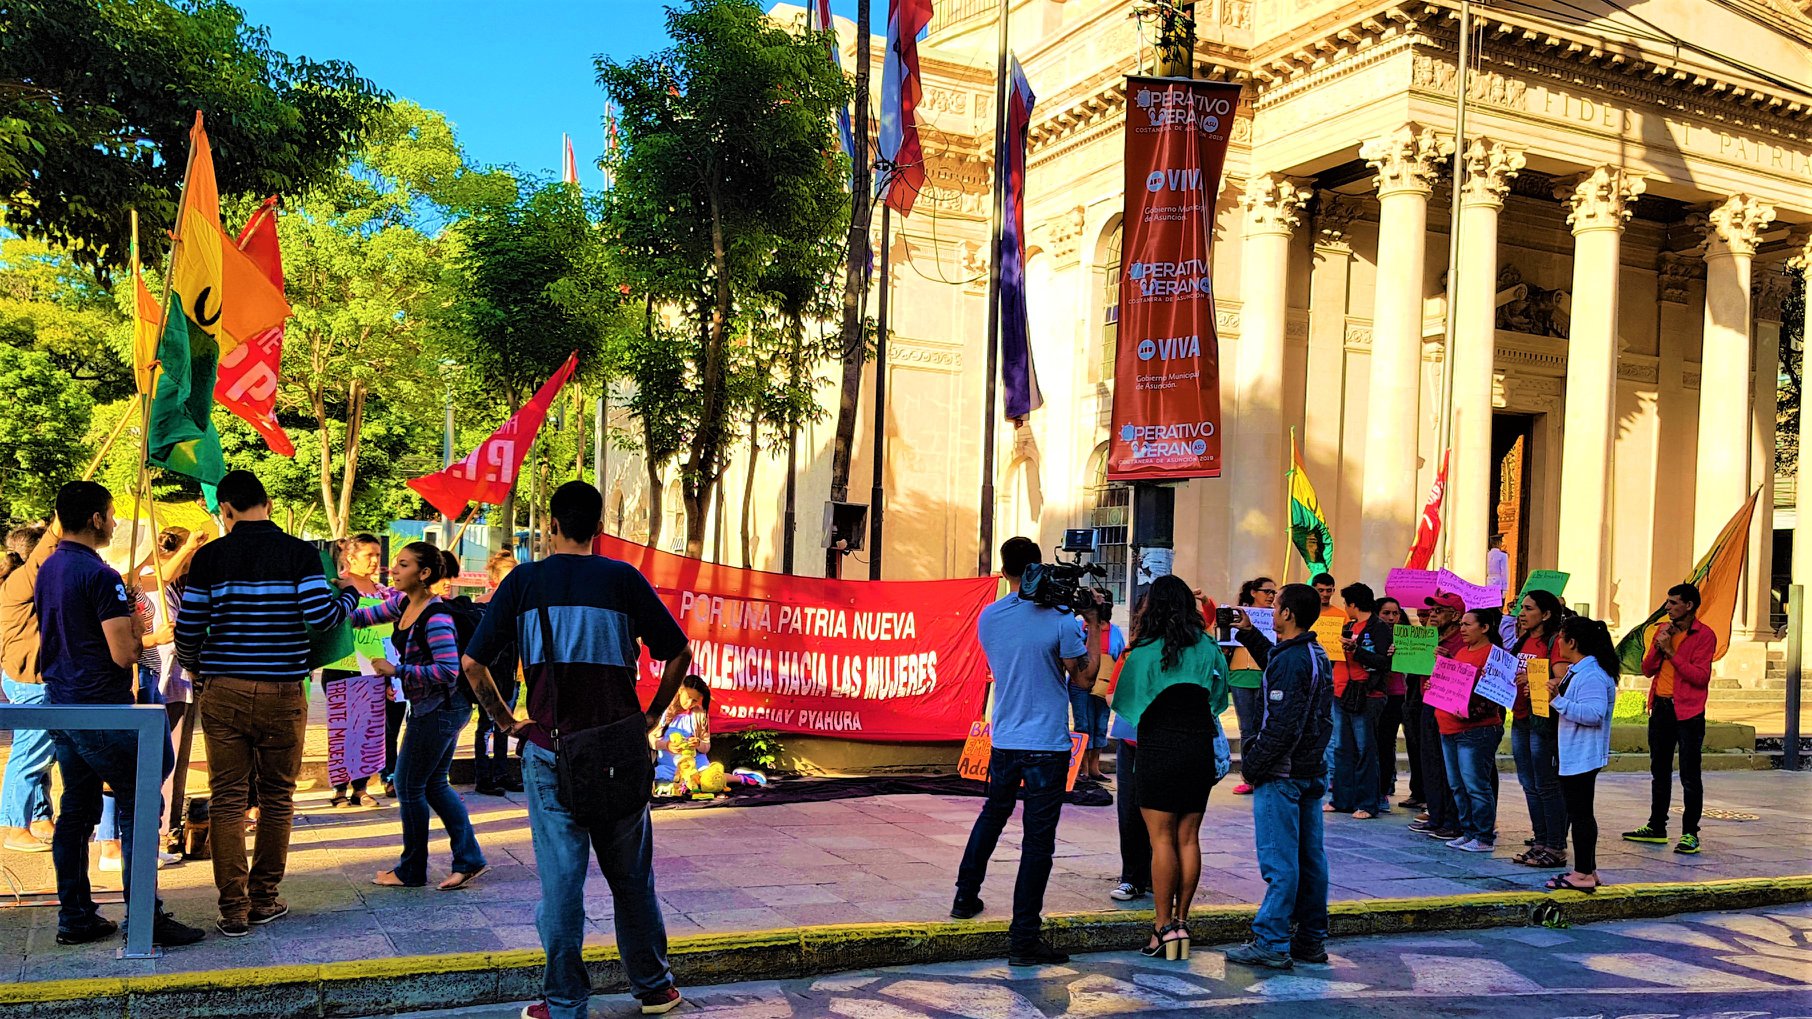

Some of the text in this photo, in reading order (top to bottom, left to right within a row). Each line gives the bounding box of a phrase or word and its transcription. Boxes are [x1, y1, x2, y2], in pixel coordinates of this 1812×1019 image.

[1158, 335, 1200, 360] VIVA
[1136, 374, 1167, 382] Gobierno
[115, 584, 128, 602] 3
[680, 590, 916, 641] POR UNA PATRIA NUEVA
[777, 650, 828, 697] HACIA
[832, 654, 862, 700] LAS
[864, 651, 938, 700] MUJERES
[327, 680, 348, 724] FRENTE
[798, 710, 862, 731] PYAHURA
[327, 728, 348, 767] MUJER
